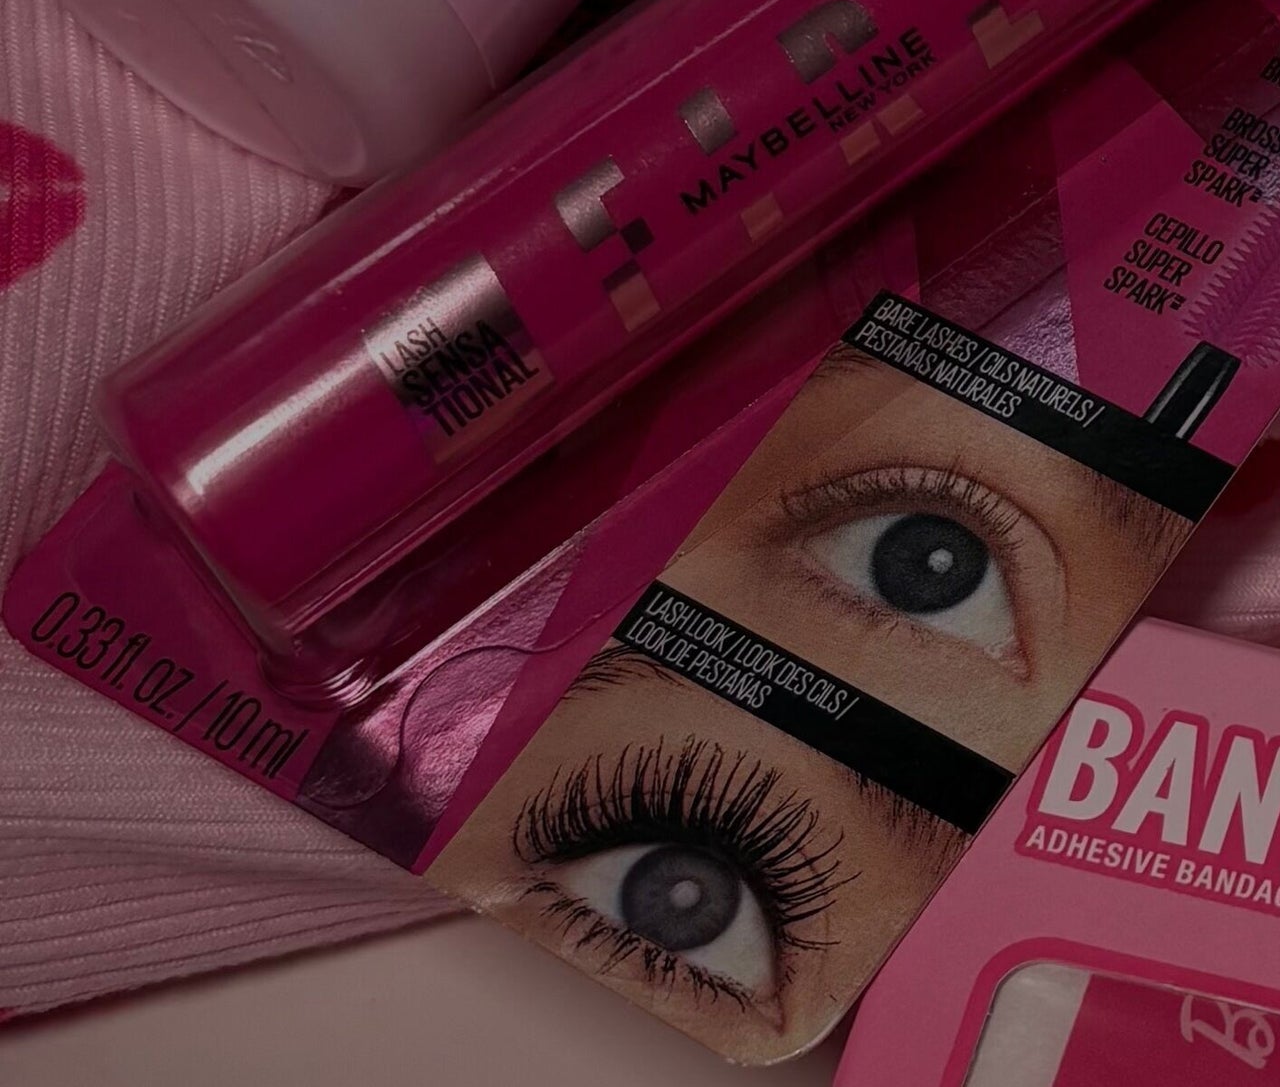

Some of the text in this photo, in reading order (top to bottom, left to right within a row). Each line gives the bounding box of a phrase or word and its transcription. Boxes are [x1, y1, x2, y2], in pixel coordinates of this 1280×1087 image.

[680, 27, 925, 214] MAYBELLINE
[828, 51, 937, 133] NEW YORK
[1203, 134, 1270, 180] SUPER
[1124, 239, 1193, 287] SUPER
[1144, 213, 1225, 265] CEPILLO
[380, 317, 448, 375] LASH
[402, 319, 502, 408] SENSA
[424, 338, 540, 436] TIONAL
[859, 320, 1023, 420] PESTAÑAS NATURALES
[873, 298, 924, 335] BARE
[917, 322, 979, 362] LASHES
[980, 350, 1019, 384] CILS
[1013, 362, 1095, 420] NATURELS
[31, 591, 125, 669] 0.33
[100, 632, 152, 690] fl.
[134, 658, 195, 719] oz.
[203, 690, 262, 751] 10
[238, 718, 311, 779] ml
[626, 616, 772, 709] LOOK DE PESTAÑAS
[646, 591, 692, 633] LASH
[686, 612, 737, 654] LOOK
[734, 638, 786, 679] LOOK
[774, 663, 815, 696] DES
[806, 678, 849, 714] CILS
[1025, 824, 1168, 879] ADHESIVE
